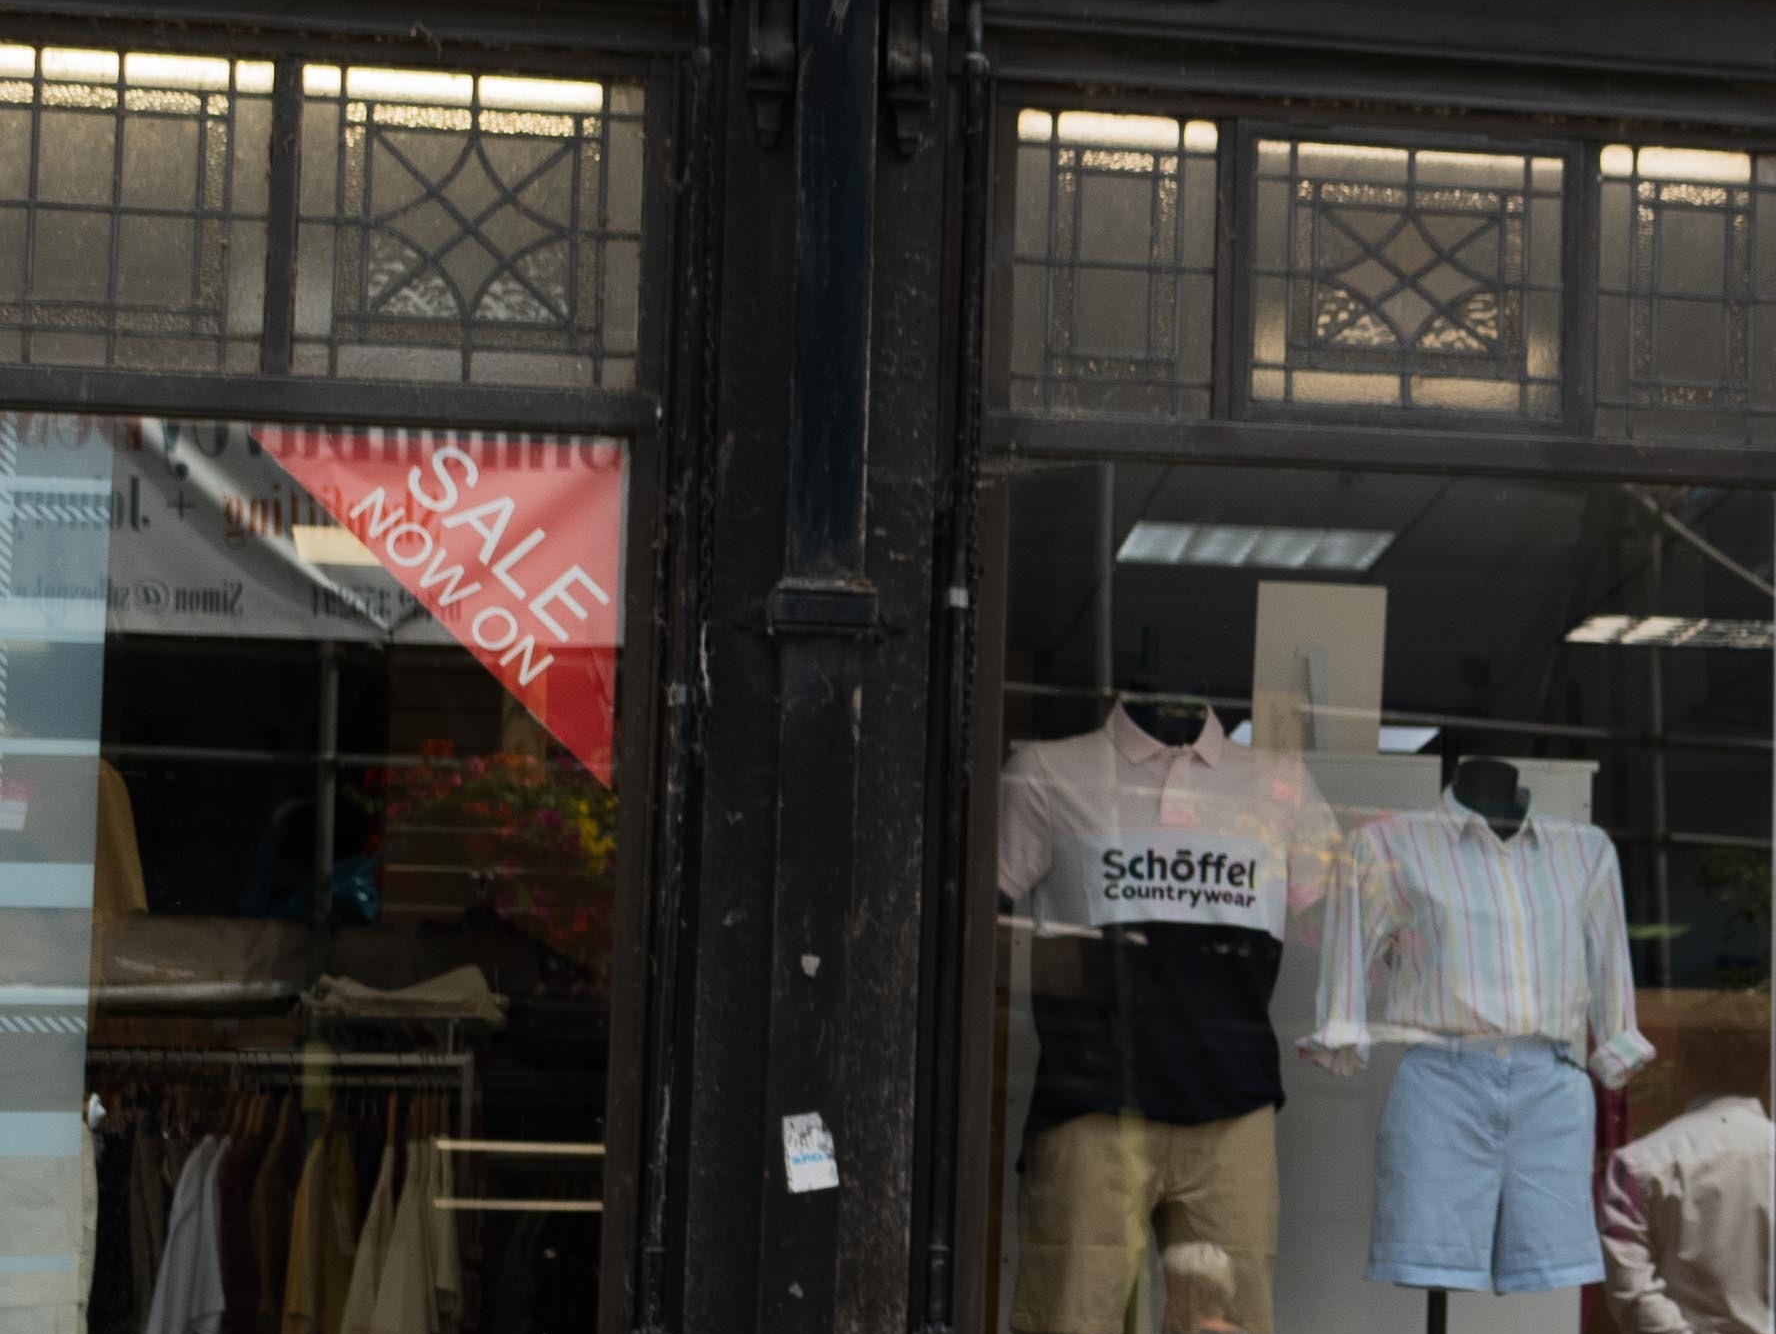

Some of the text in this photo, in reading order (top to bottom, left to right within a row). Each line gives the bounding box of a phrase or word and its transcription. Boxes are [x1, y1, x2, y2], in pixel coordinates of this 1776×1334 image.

[350, 486, 482, 607] NOW
[470, 605, 555, 687] ON
[407, 445, 610, 643] SALE
[1102, 848, 1256, 890] Schöffel
[1103, 883, 1256, 908] Countrywear
